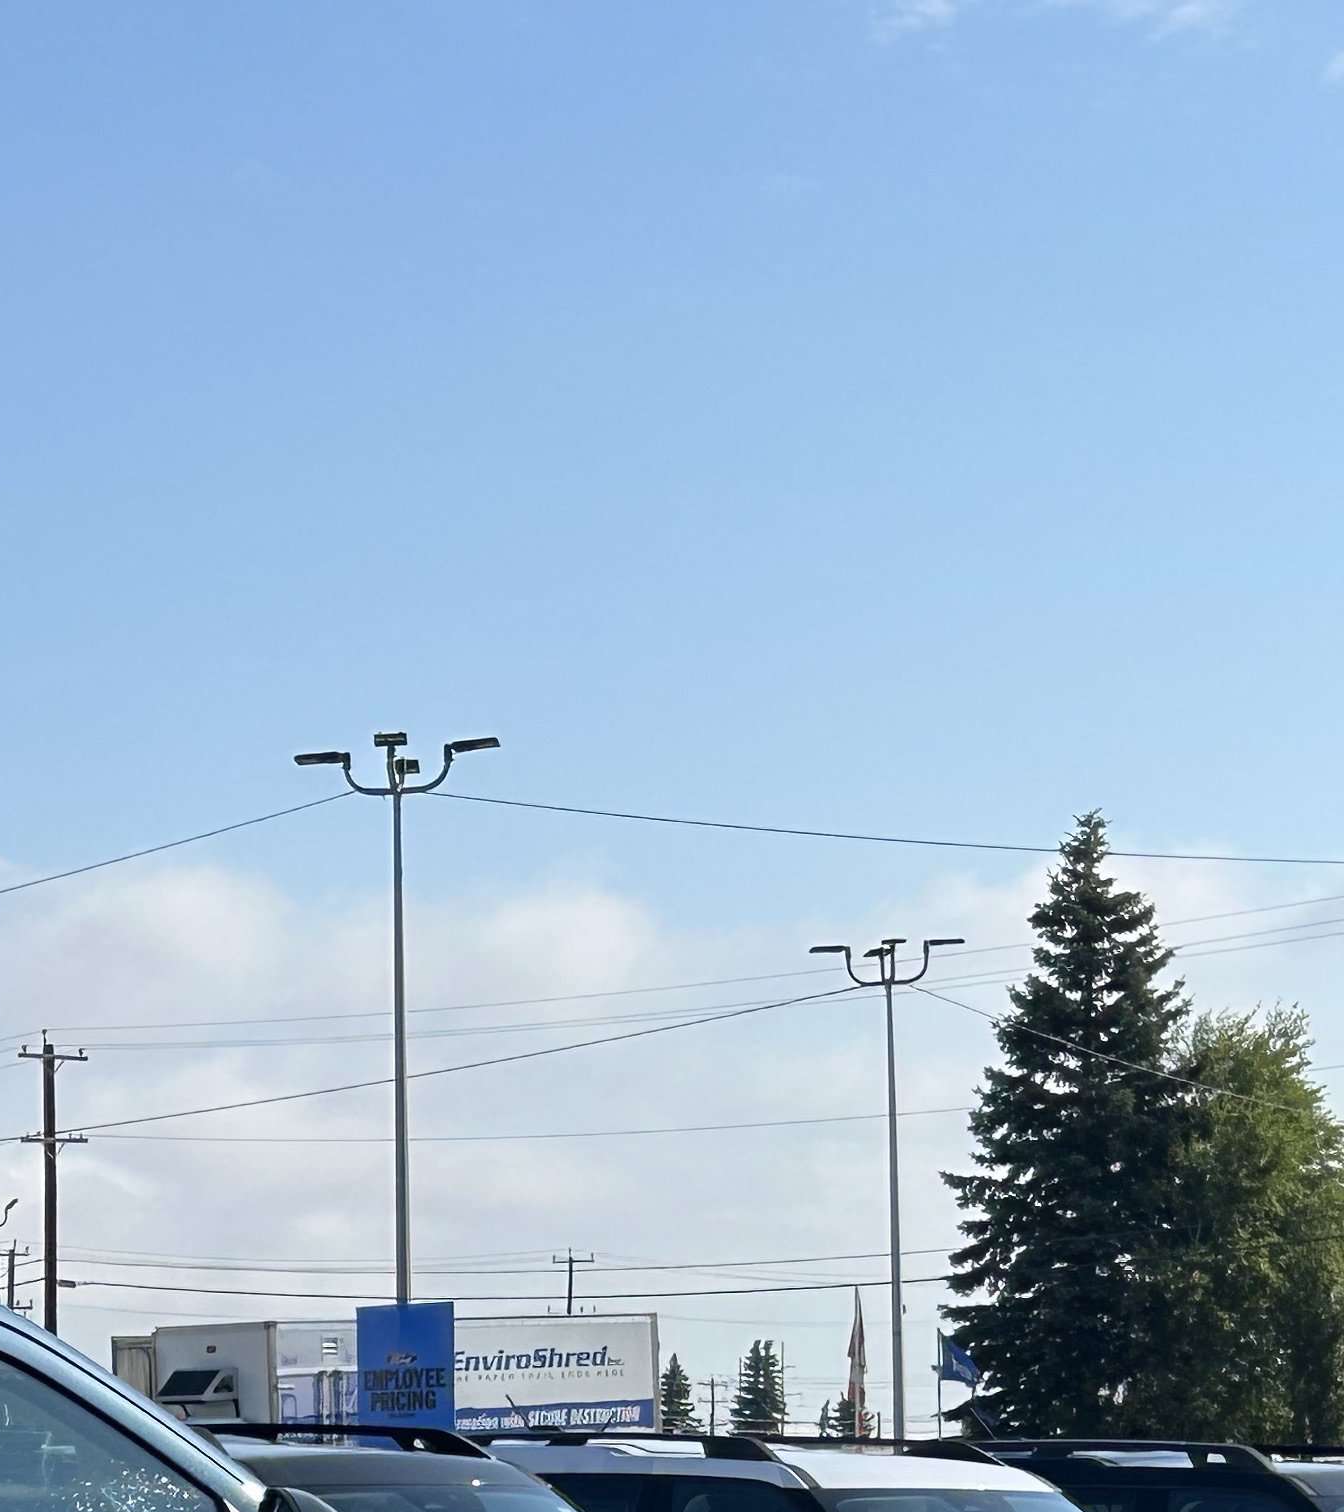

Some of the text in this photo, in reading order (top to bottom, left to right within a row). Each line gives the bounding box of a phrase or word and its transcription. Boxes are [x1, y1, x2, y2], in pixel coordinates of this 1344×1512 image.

[455, 1345, 609, 1372] EnviroShred
[364, 1367, 446, 1391] EMPLOYEE
[370, 1390, 437, 1413] PRICING
